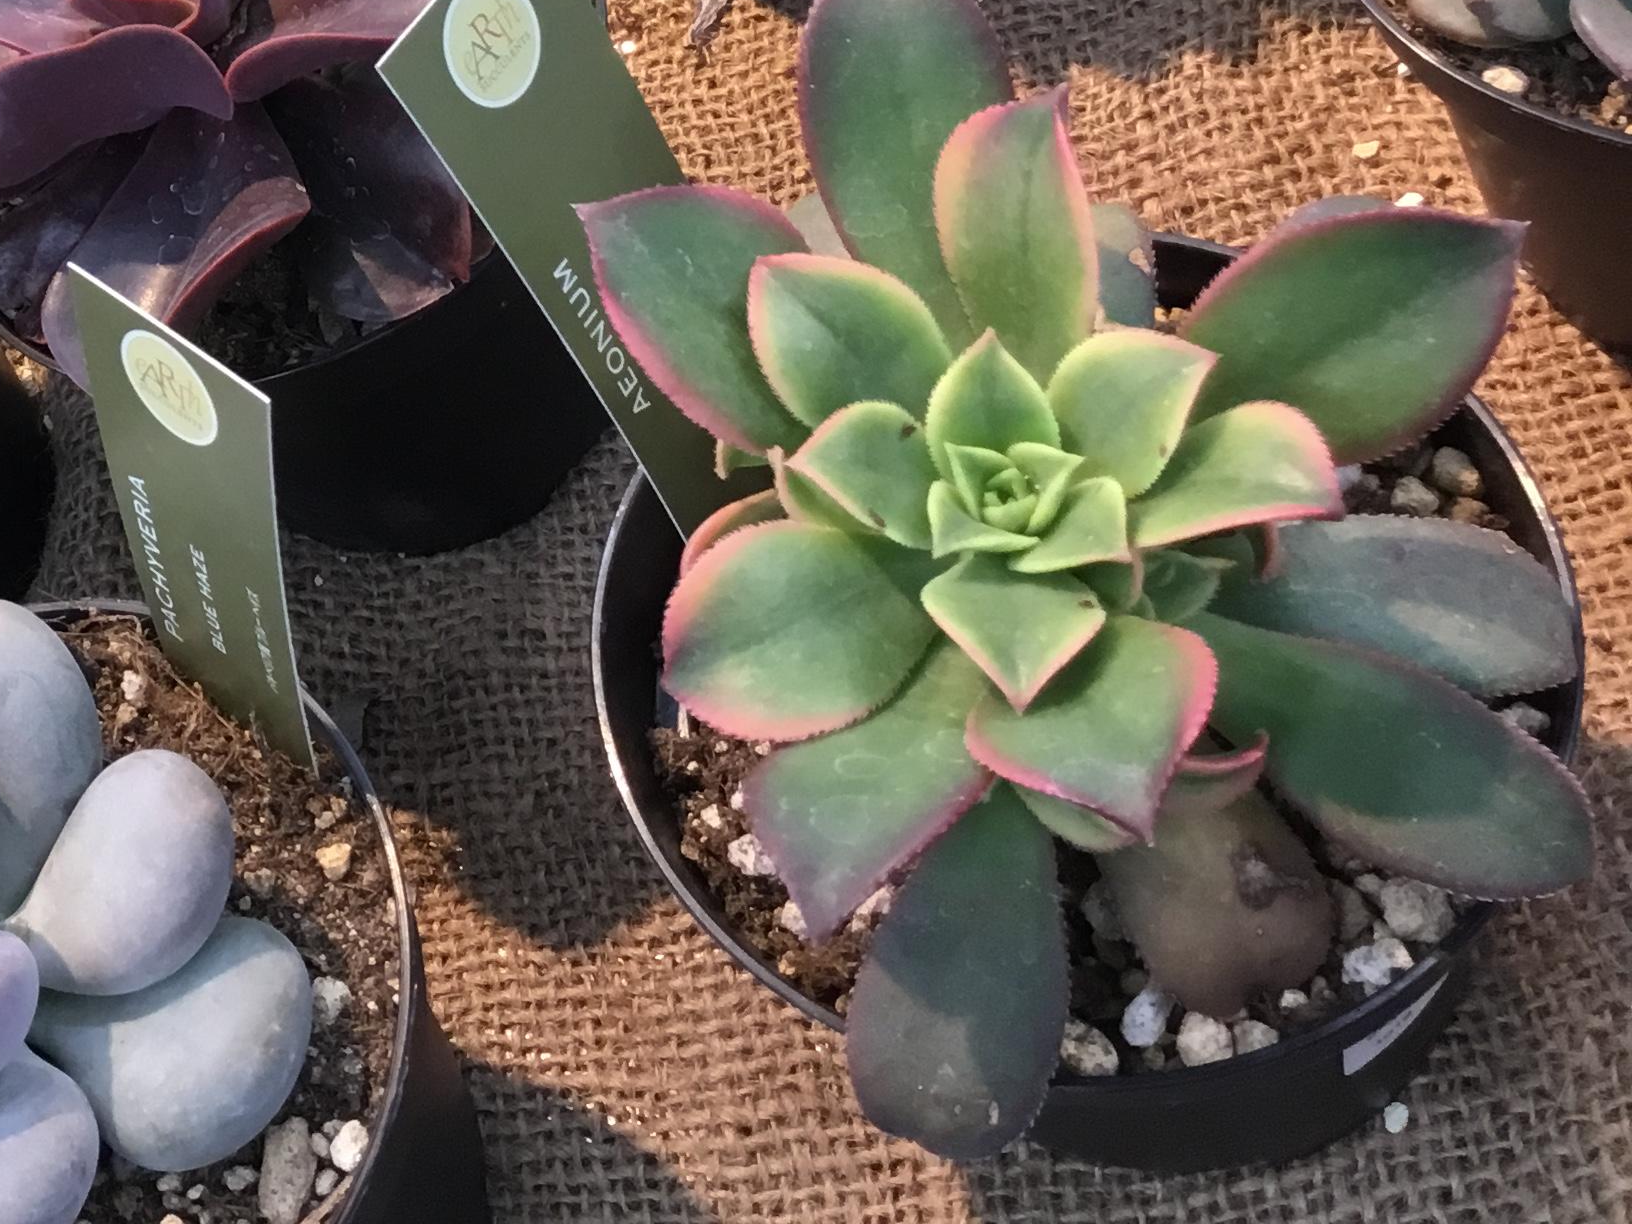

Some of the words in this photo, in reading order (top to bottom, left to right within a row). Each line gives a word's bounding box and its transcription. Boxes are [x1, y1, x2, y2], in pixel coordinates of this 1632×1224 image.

[553, 257, 652, 414] AEONIUM
[128, 475, 184, 643] PACHYVERIA
[188, 544, 214, 601] HAZE
[202, 601, 227, 655] BLUE
